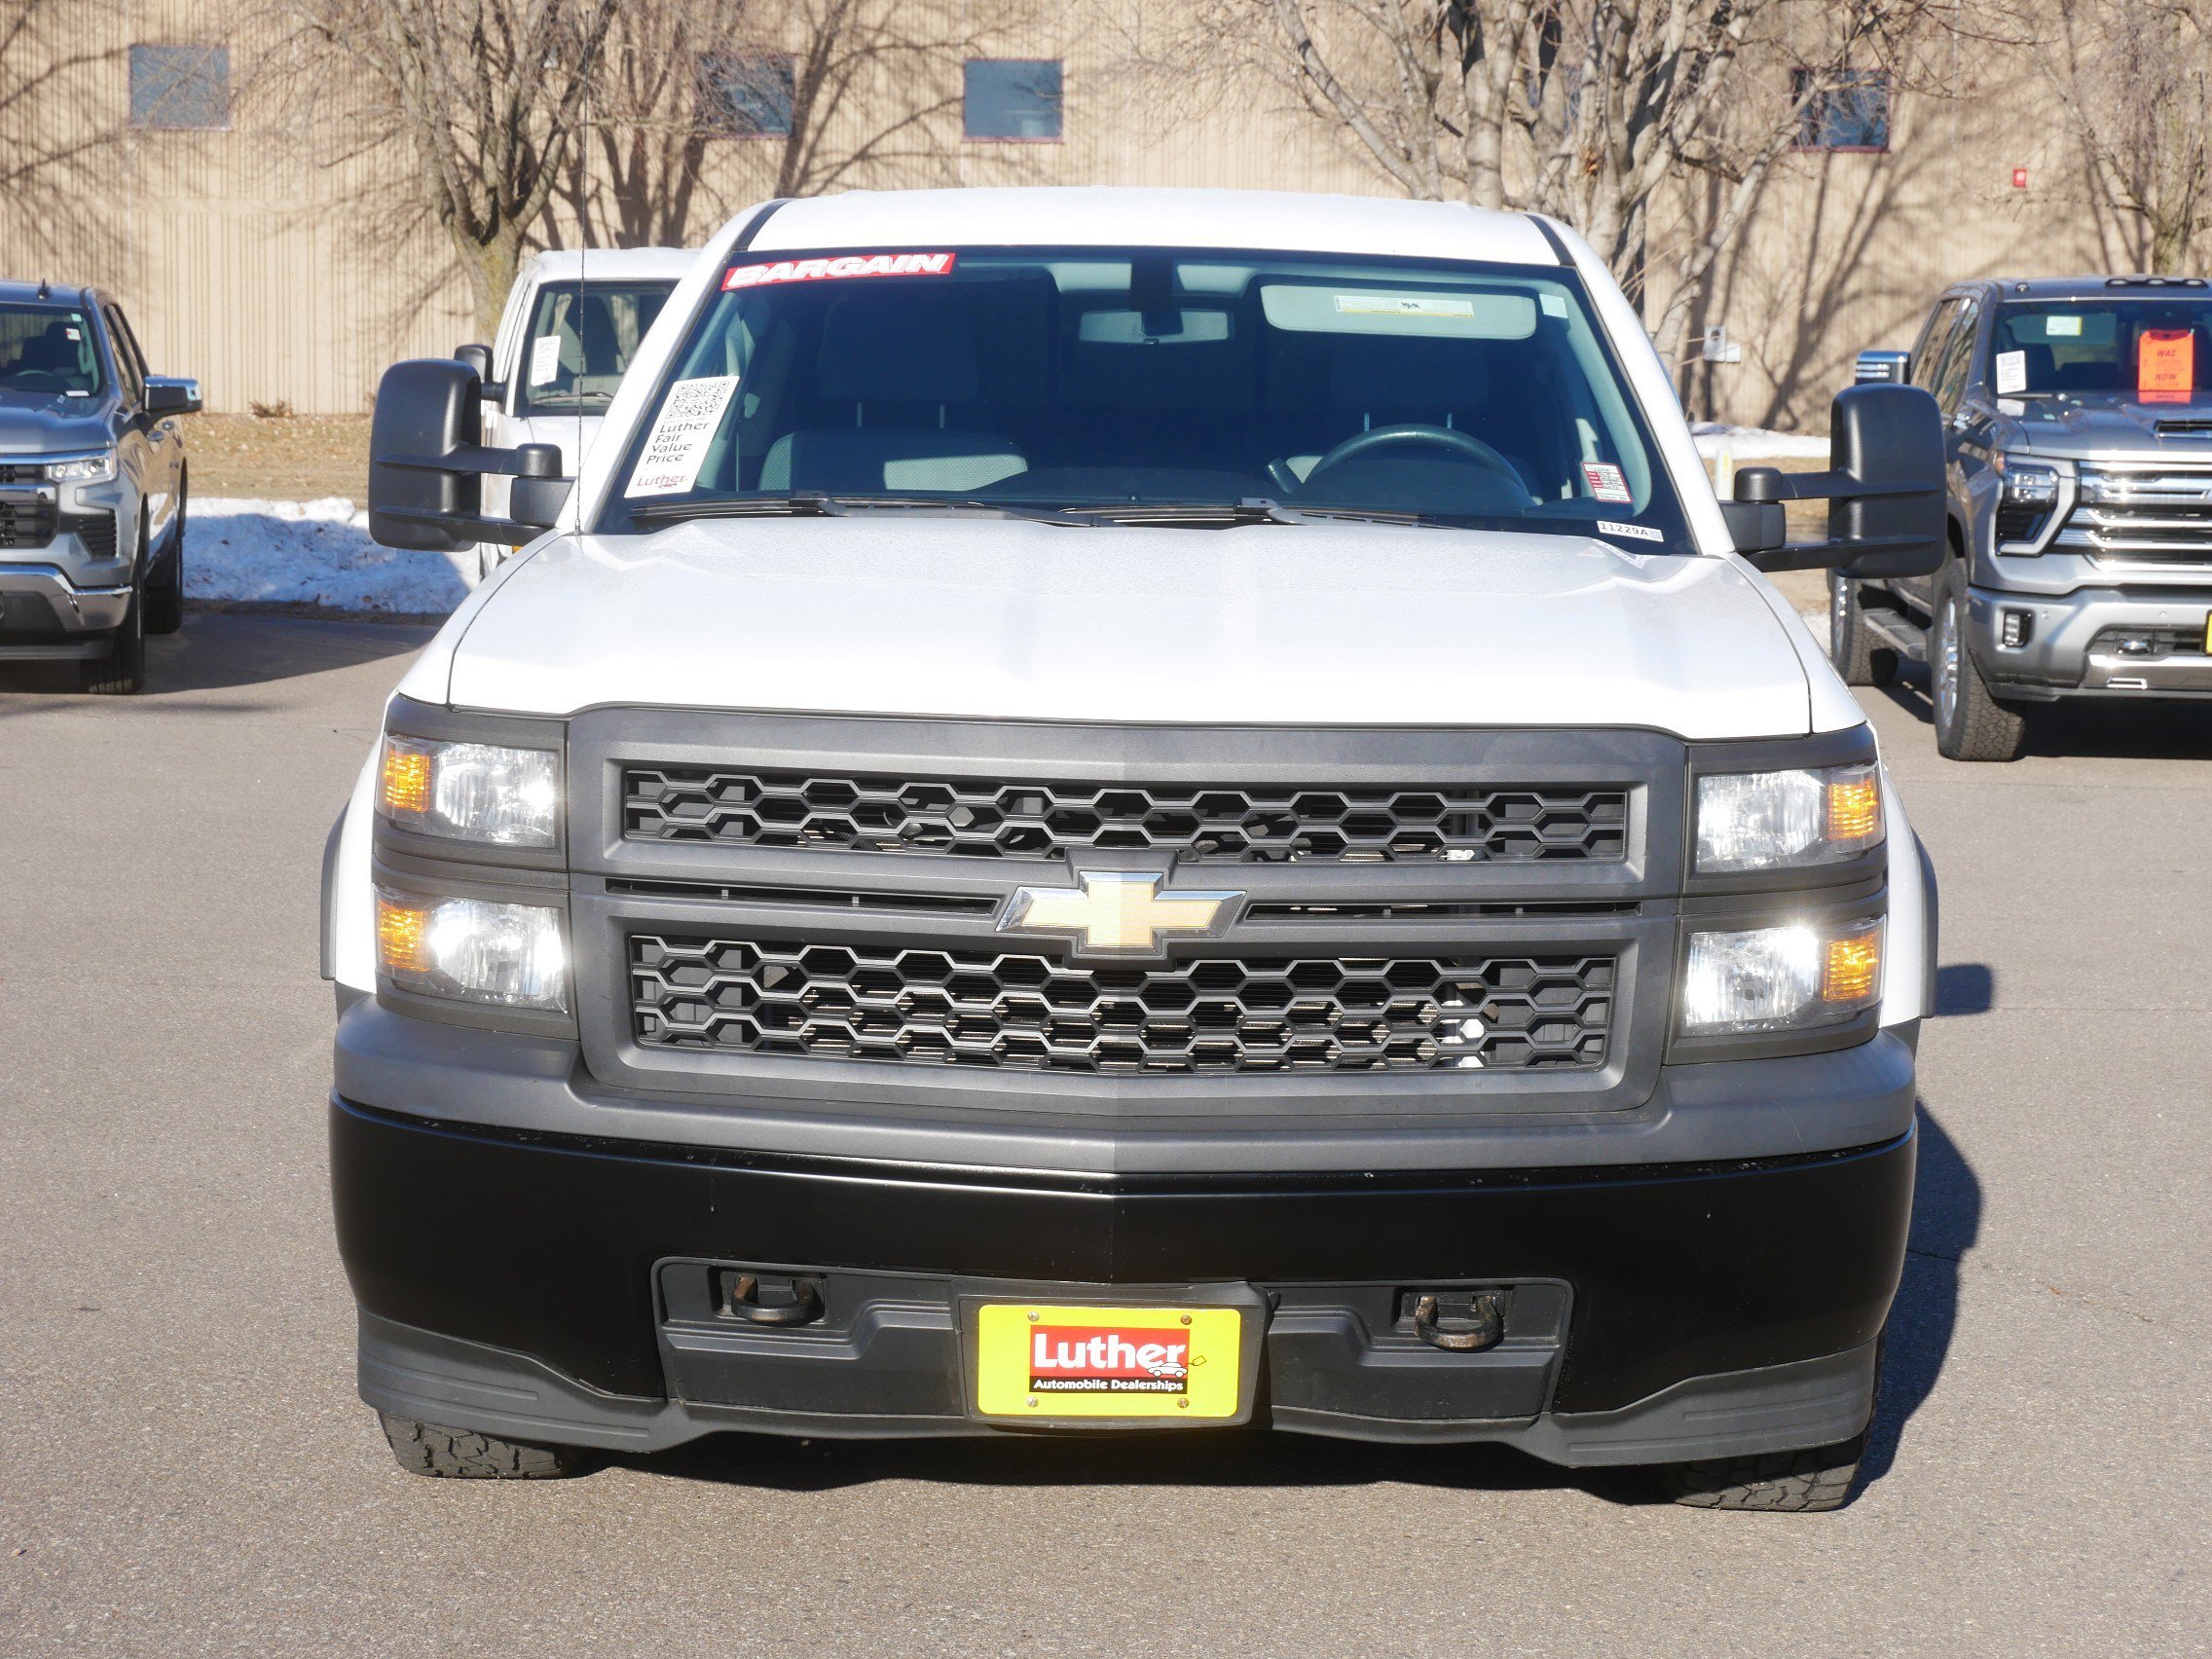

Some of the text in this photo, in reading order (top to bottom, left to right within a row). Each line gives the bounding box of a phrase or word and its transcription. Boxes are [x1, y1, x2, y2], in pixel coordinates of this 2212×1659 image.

[727, 254, 949, 287] BARGAIN
[659, 423, 710, 433] Luther
[655, 433, 682, 444] Fair
[652, 443, 693, 453] Value
[646, 453, 684, 463] Price
[637, 474, 686, 487] Luther
[1600, 523, 1648, 535] 11229A
[1034, 1333, 1187, 1370] Luther
[1033, 1379, 1184, 1392] Automobile Dealerships
